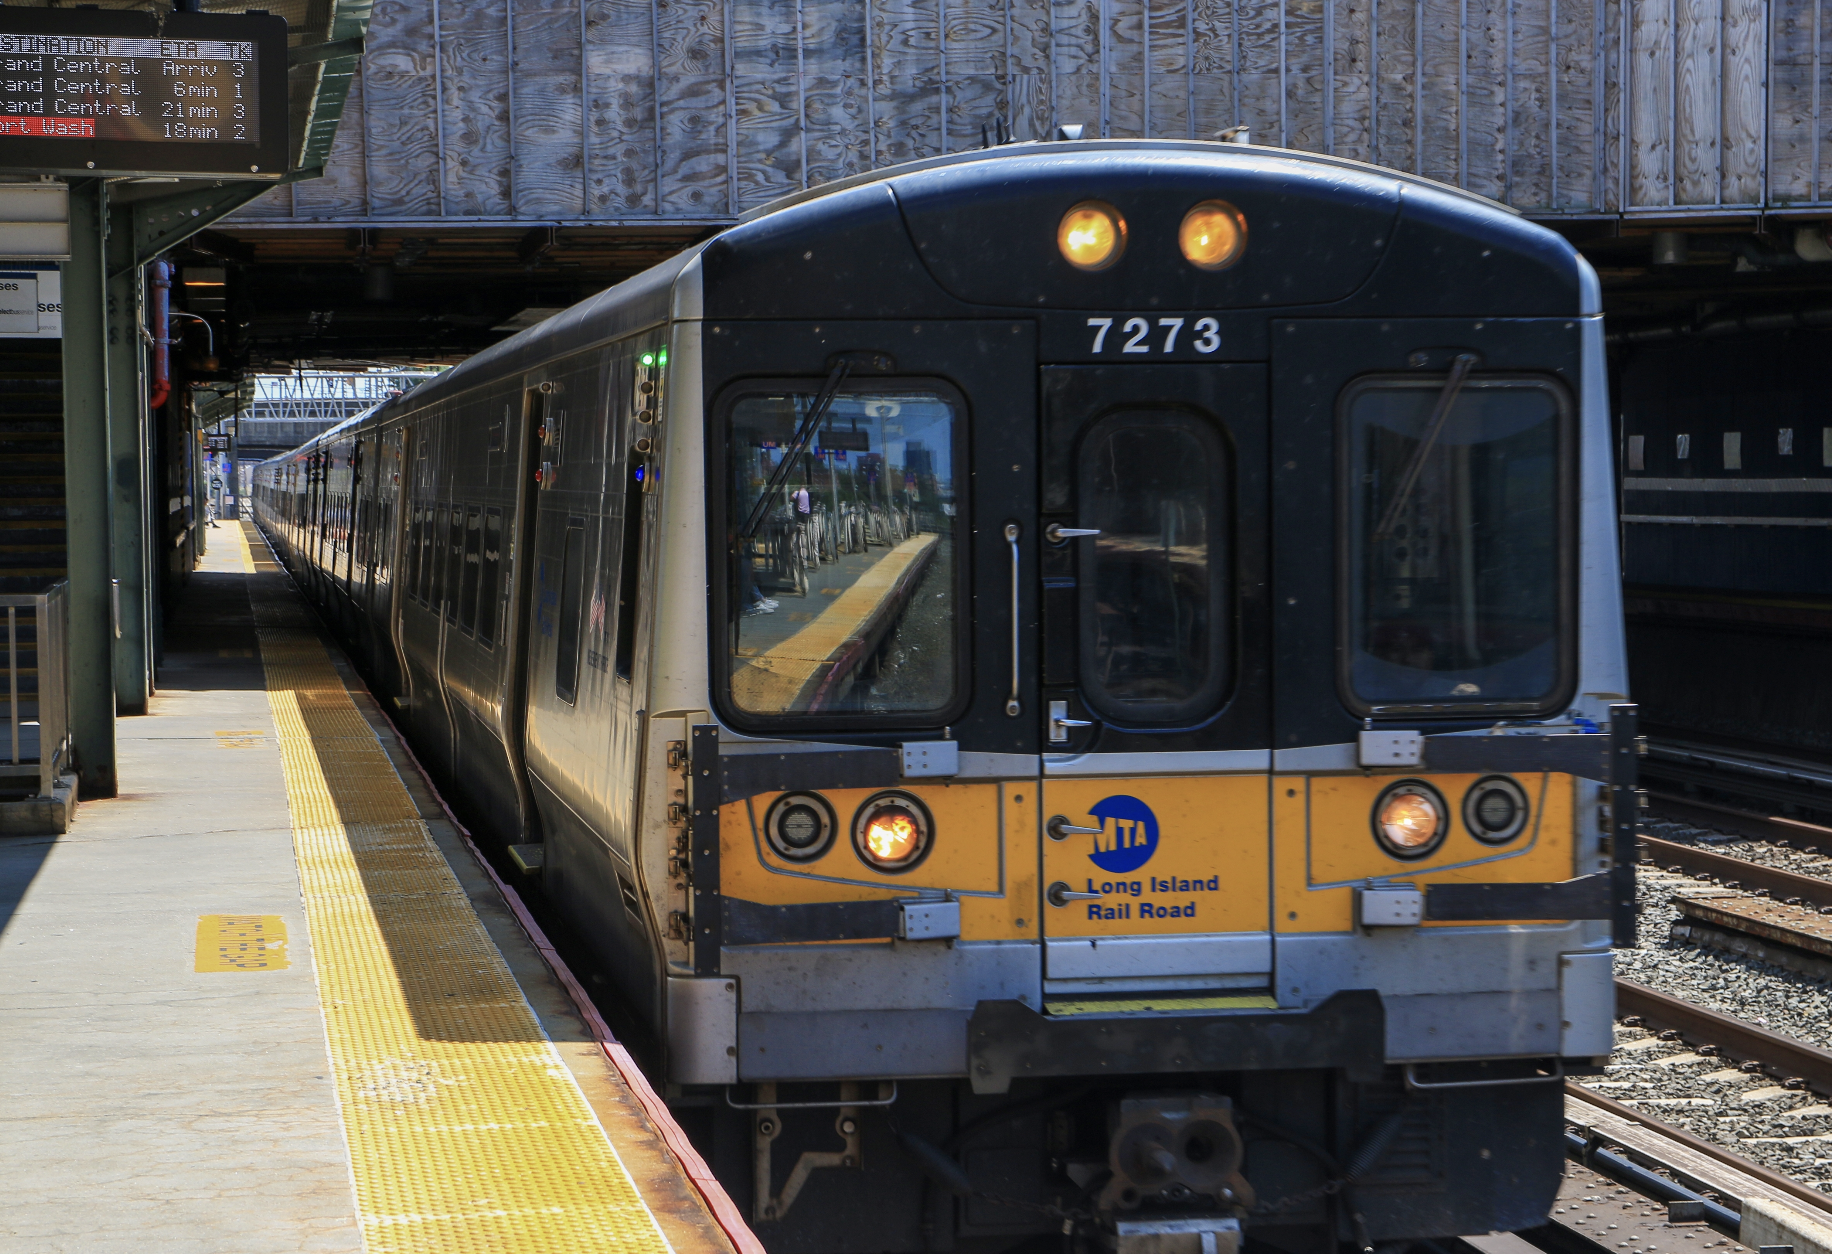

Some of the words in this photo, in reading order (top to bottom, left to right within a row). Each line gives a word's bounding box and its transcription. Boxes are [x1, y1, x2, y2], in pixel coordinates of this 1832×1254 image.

[161, 41, 198, 58] ETA
[226, 43, 251, 60] TK
[0, 56, 42, 72] and
[54, 56, 141, 76] Central
[163, 60, 217, 77] Arriv
[233, 62, 245, 78] 3
[0, 77, 43, 92] and
[54, 77, 141, 95] Central
[174, 81, 218, 98] 6min
[234, 82, 243, 98] 1
[54, 98, 142, 117] Central
[161, 101, 218, 119] 21min
[233, 103, 245, 119] 3
[42, 118, 94, 136] Wash
[164, 122, 218, 139] 18min
[233, 124, 245, 140] 2
[1086, 317, 1222, 354] 7273
[1086, 877, 1142, 897] Long
[1150, 875, 1220, 892] Island
[1087, 903, 1130, 920] Rail
[1139, 901, 1197, 919] Road
